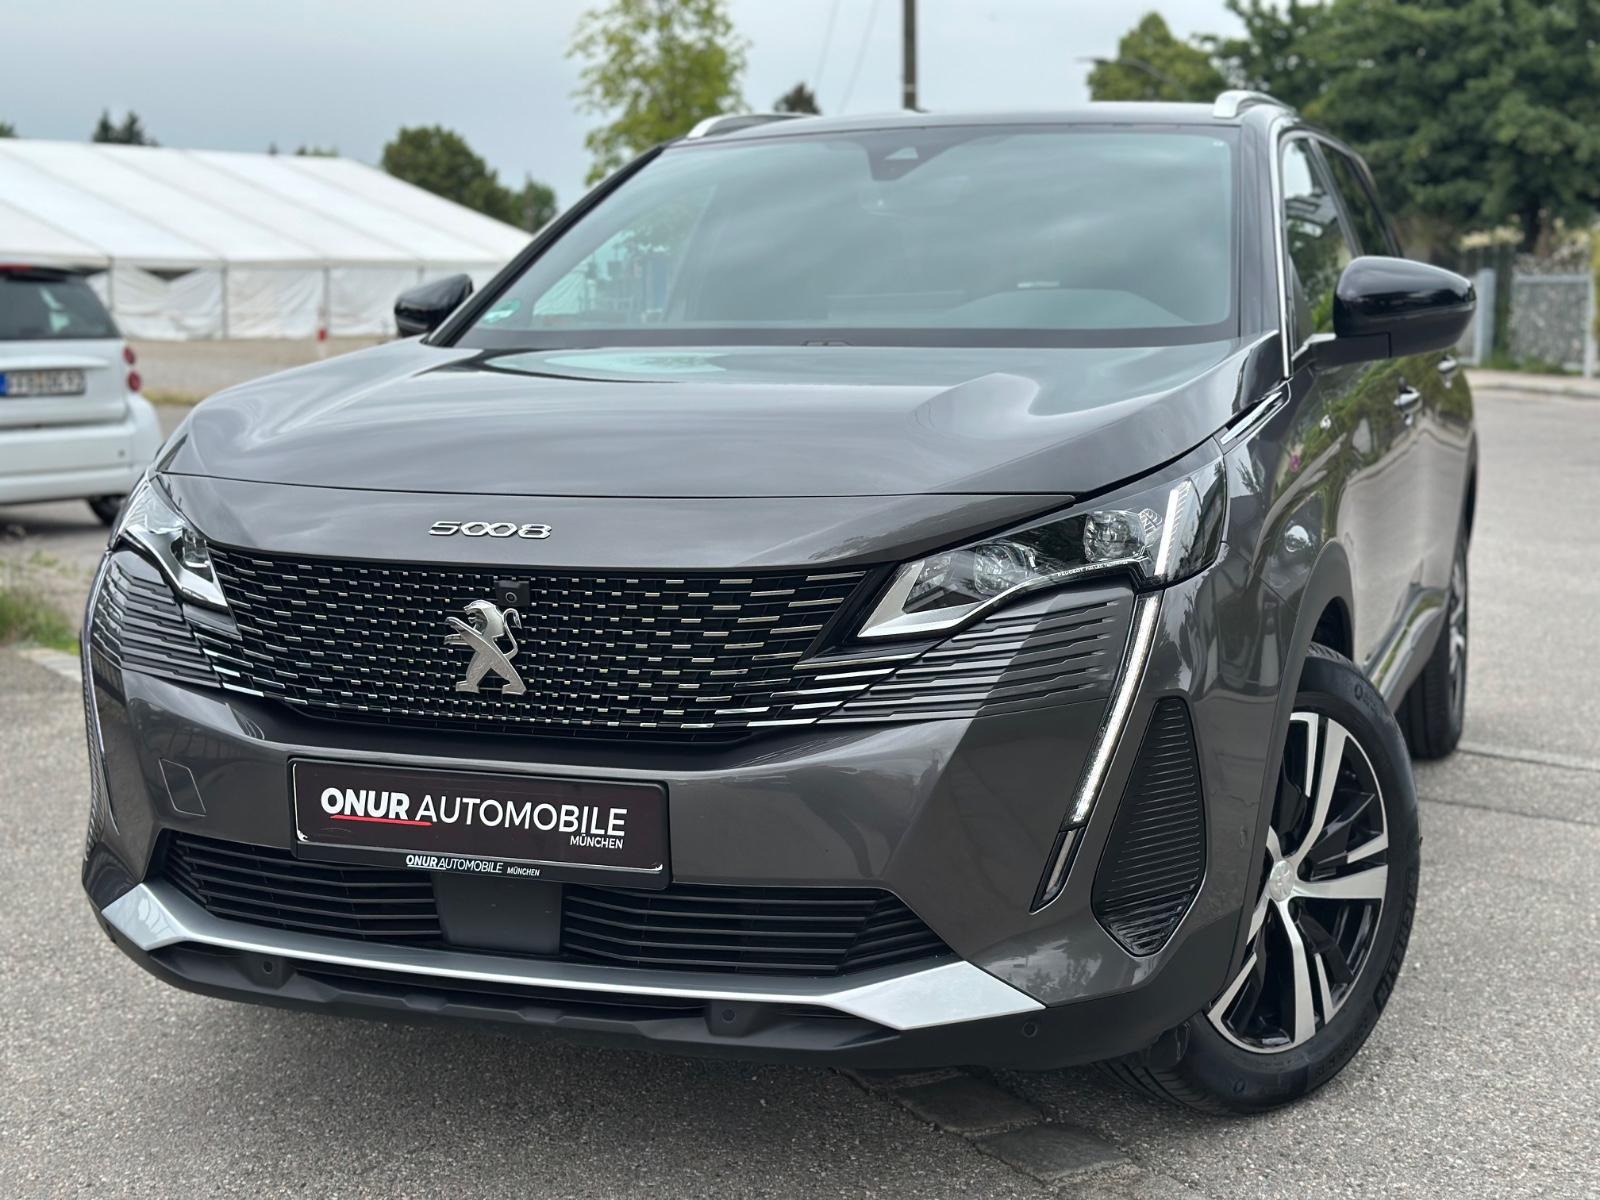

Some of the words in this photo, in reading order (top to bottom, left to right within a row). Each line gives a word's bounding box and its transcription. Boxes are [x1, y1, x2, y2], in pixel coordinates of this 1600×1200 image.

[428, 521, 552, 539] 5008
[320, 787, 408, 819] ONUR
[415, 795, 627, 836] AUTOMOBILE
[570, 834, 624, 850] MÜNCHEN
[406, 854, 438, 867] ONUR
[438, 857, 503, 874] AUTOMOBILE
[506, 866, 540, 876] MÜNCHEN
